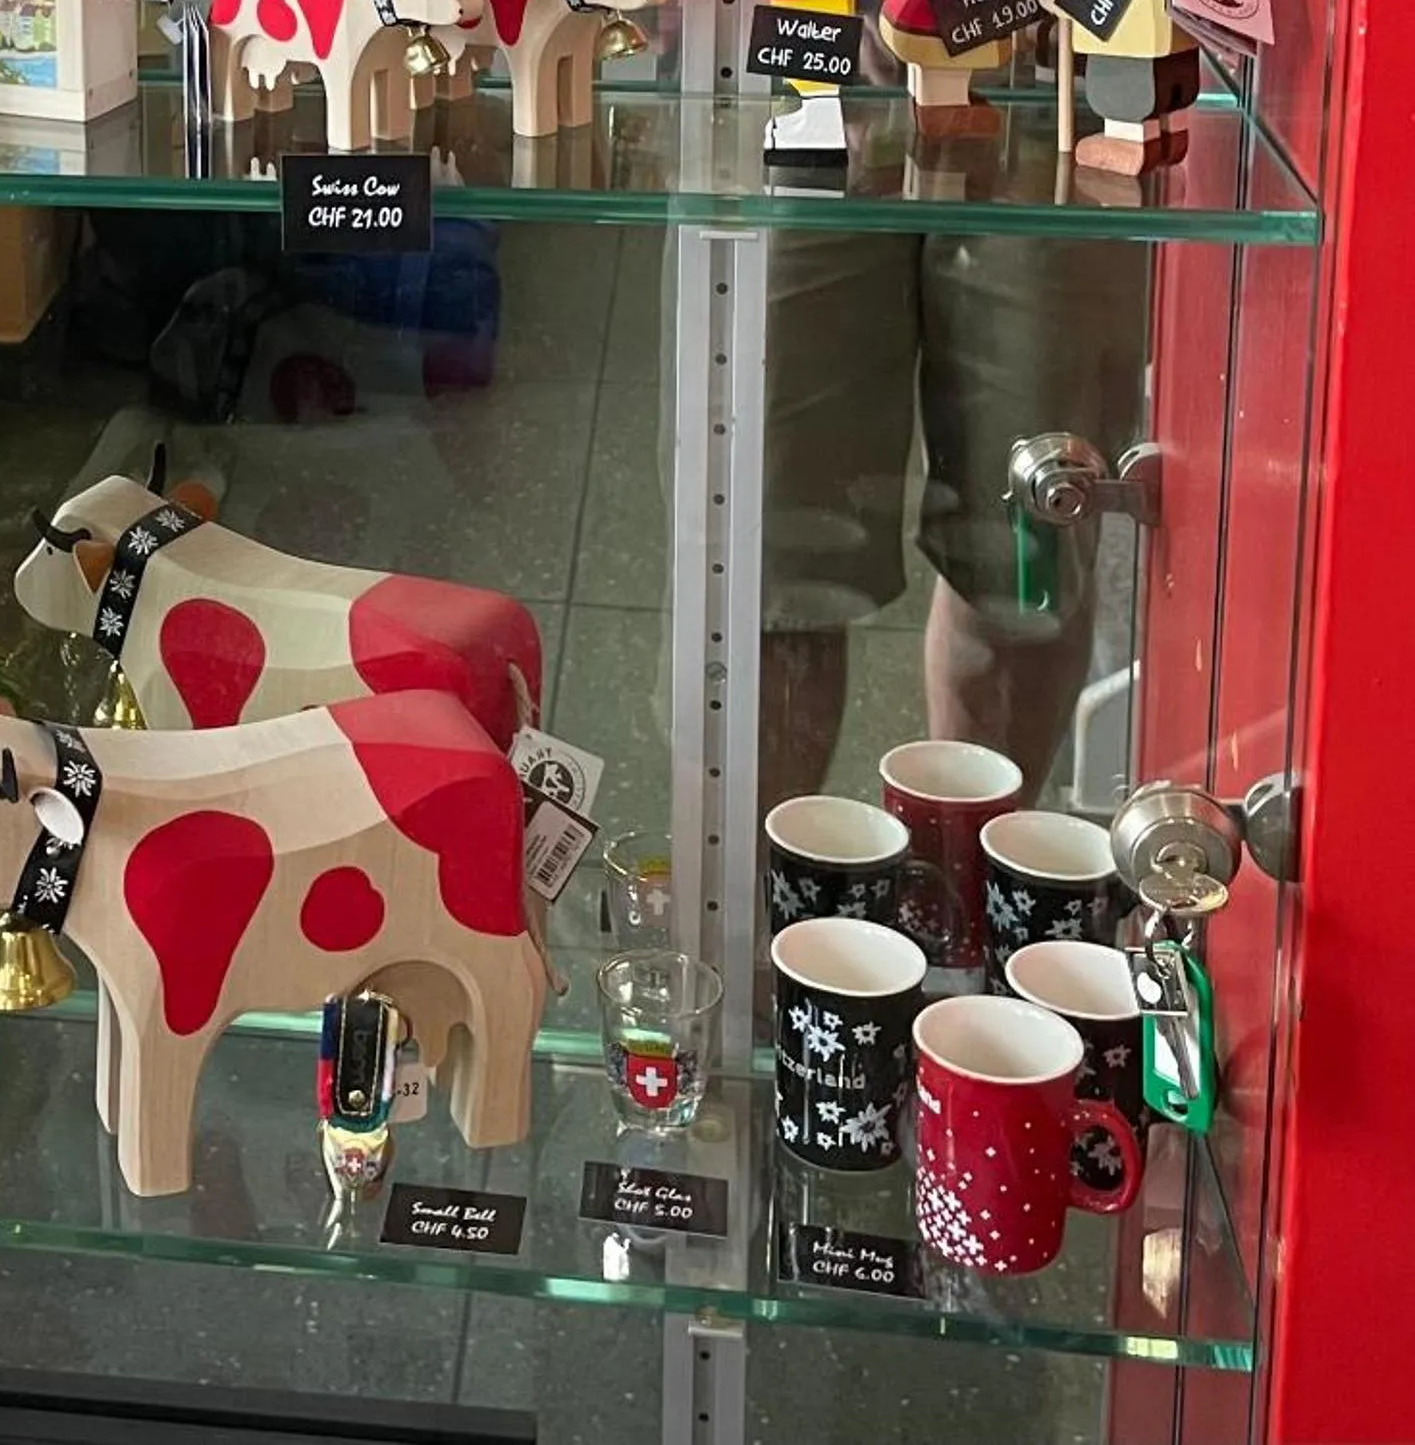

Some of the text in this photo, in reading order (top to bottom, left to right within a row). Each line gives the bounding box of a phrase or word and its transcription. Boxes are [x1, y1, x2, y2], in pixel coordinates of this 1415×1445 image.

[776, 18, 842, 43] Walter
[951, 17, 983, 44] CHF
[757, 47, 852, 76] CHF 25.00
[312, 174, 401, 197] Swiss Cow
[308, 206, 404, 229] CHF 21.00
[776, 1050, 866, 1090] tzerland
[411, 1201, 497, 1222] Small Bell
[614, 1198, 693, 1219] CHF 5.00
[411, 1221, 489, 1240] CHF 4.50
[813, 1240, 855, 1259] Mini
[812, 1259, 895, 1283] CHF 6.00
